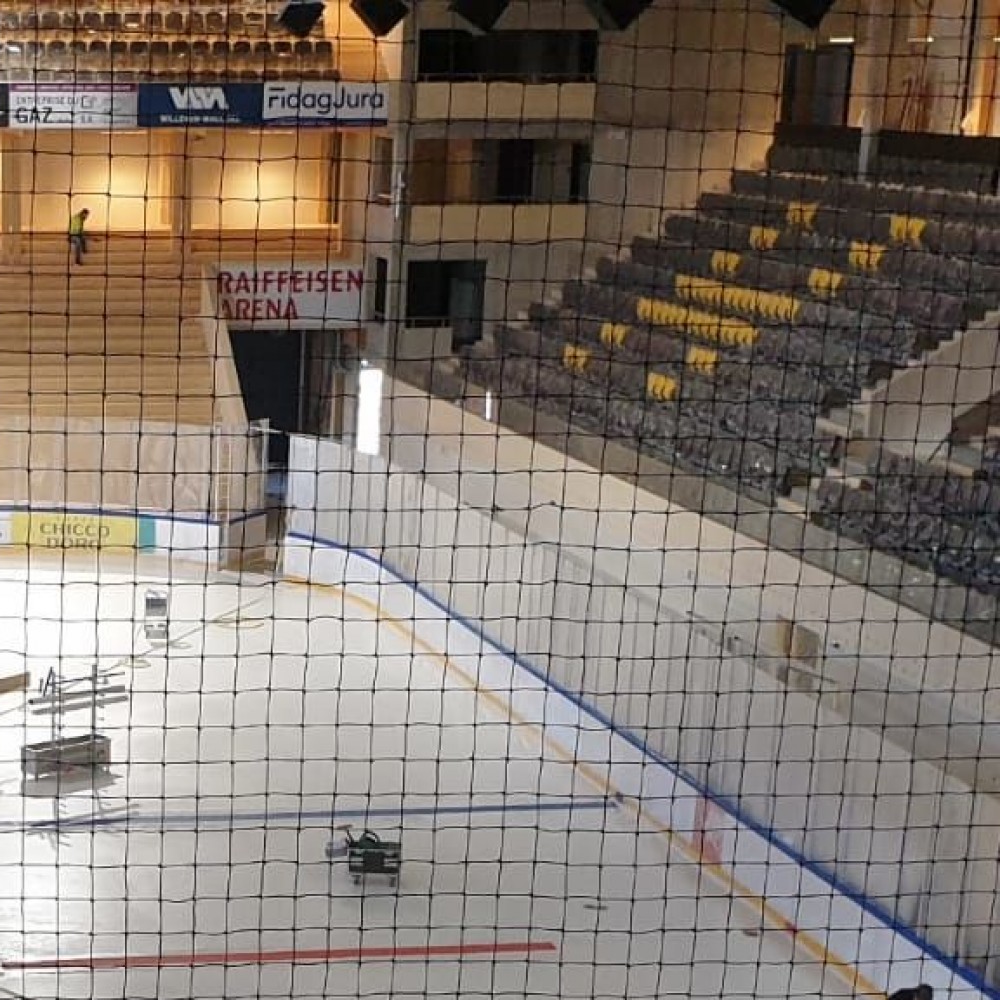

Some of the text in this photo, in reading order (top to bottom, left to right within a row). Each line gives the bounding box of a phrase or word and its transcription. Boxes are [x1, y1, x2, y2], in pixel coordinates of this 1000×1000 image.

[268, 87, 384, 114] FidagJura
[218, 270, 363, 294] RAIFFEISEN
[221, 299, 297, 319] ARENA
